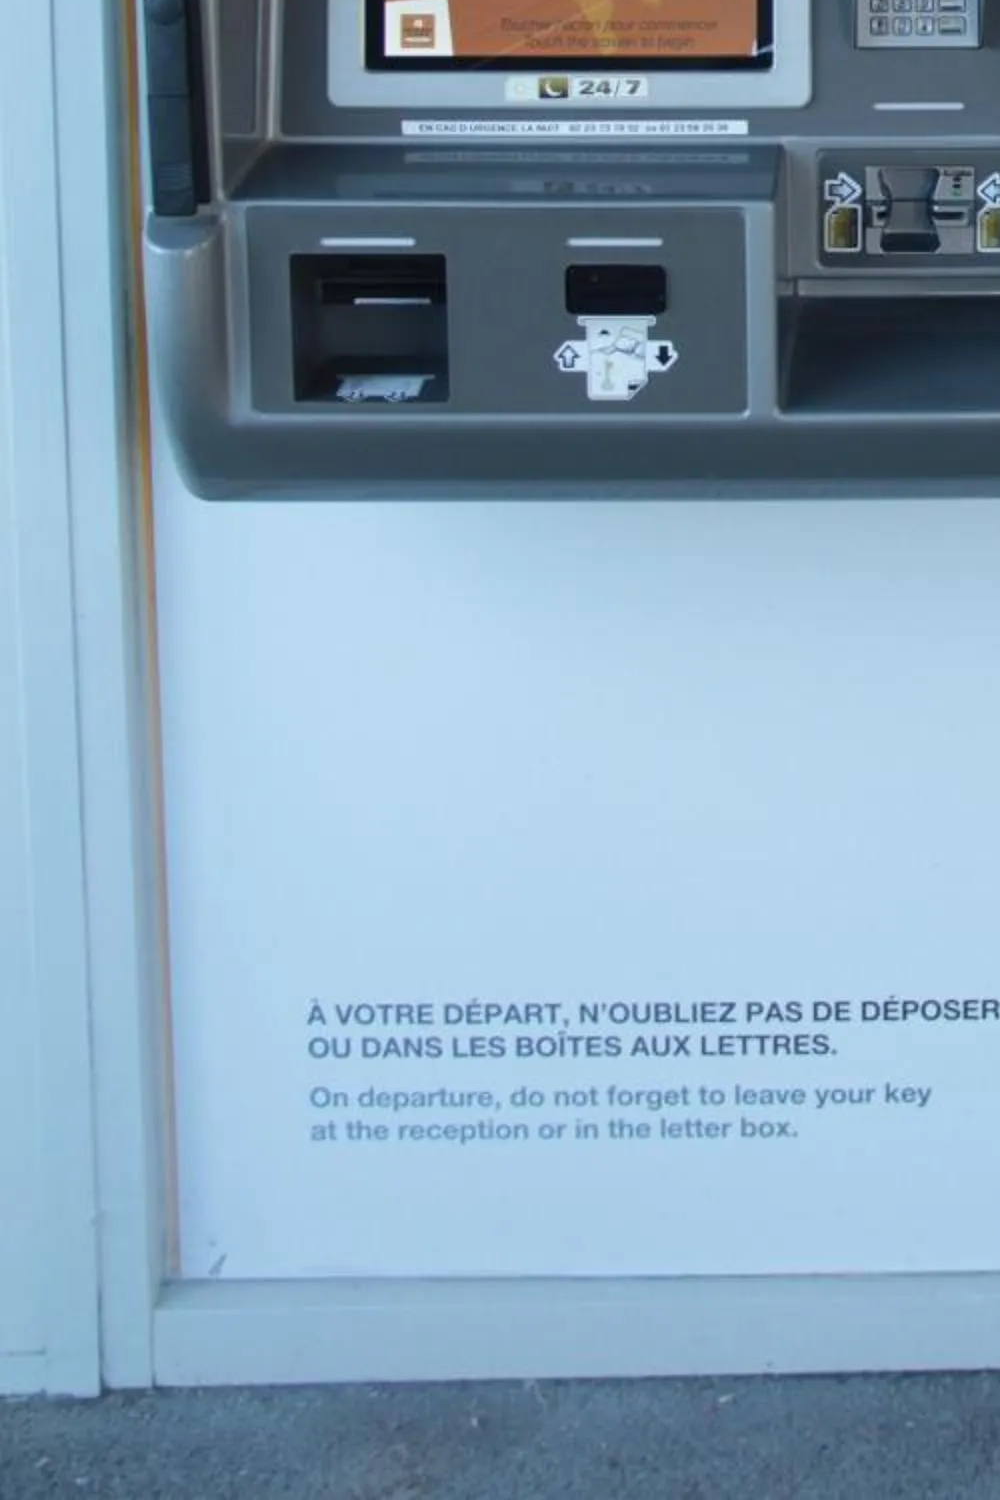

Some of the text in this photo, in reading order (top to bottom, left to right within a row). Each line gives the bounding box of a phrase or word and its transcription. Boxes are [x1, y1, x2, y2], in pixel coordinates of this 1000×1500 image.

[578, 79, 642, 96] 24/7
[307, 997, 327, 1026] À
[335, 1003, 434, 1026] VOTRE
[443, 998, 569, 1027] DÉPART,
[745, 1000, 803, 1024] PAS
[812, 1000, 852, 1023] DE
[860, 995, 1000, 1023] DÉPOSER
[307, 1030, 838, 1059] OU DANS LES BOÎTES AUX LETTRES.
[309, 1081, 933, 1113] On departure, do not forget to leave your key
[310, 1115, 799, 1146] at the reception or in the letter box.
